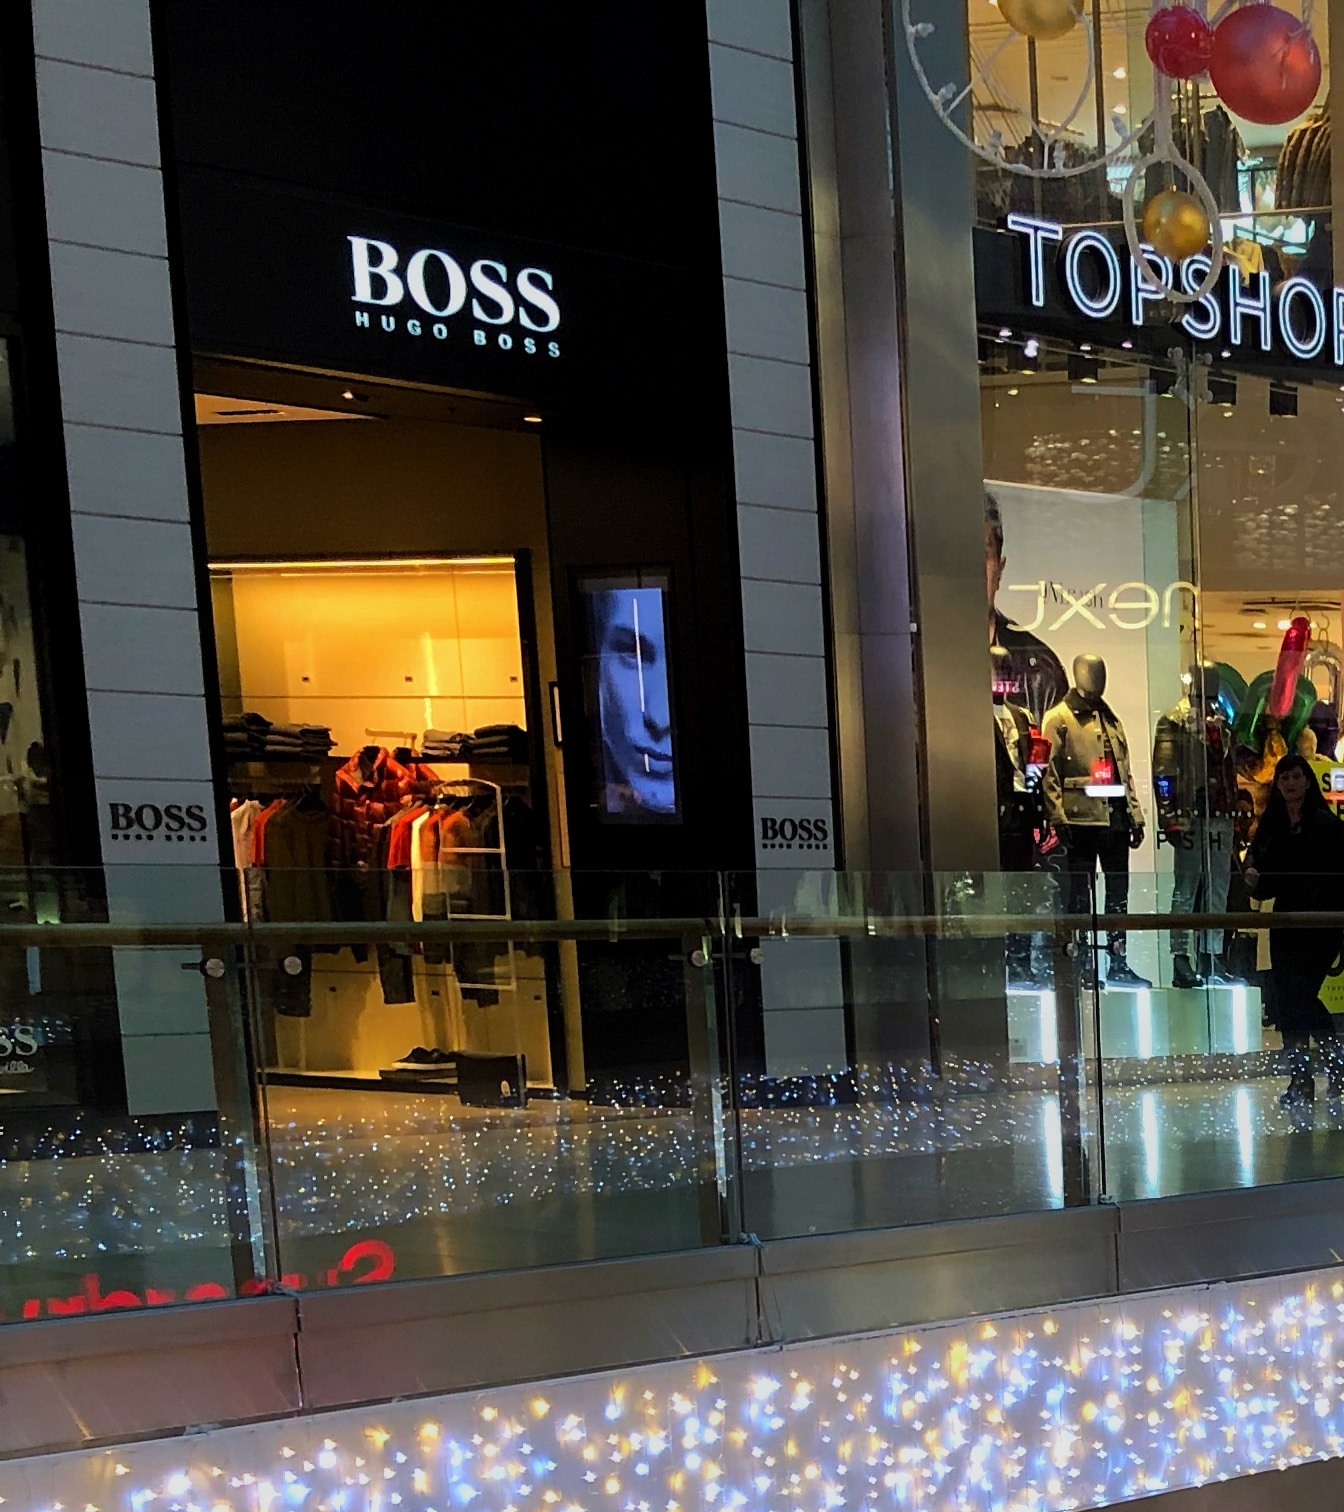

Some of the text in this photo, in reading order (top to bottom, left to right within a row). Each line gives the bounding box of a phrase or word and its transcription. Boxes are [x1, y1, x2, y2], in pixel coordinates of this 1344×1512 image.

[346, 235, 561, 333] BOSS
[355, 310, 561, 358] HUGO BOSS
[108, 802, 208, 832] BOSS
[760, 817, 828, 842] BOSS
